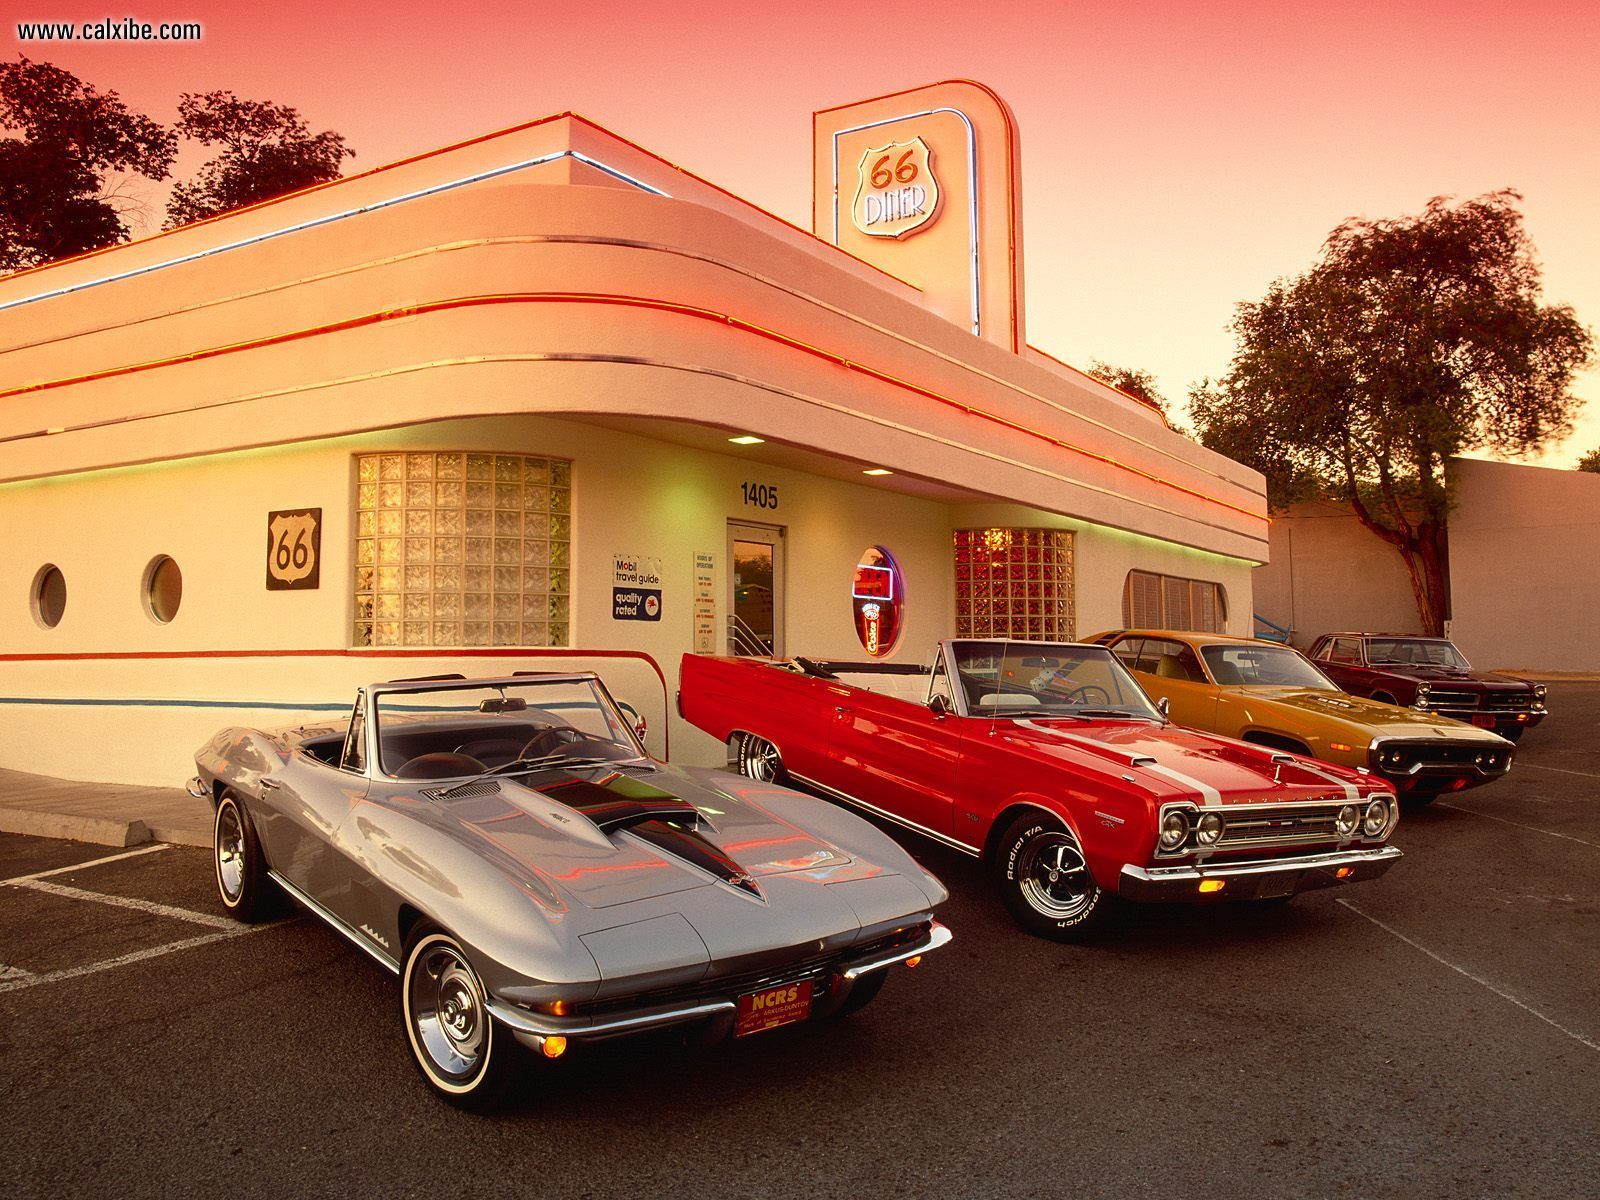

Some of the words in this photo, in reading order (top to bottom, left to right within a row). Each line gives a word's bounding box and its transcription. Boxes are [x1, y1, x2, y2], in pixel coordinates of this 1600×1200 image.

[871, 149, 918, 189] 66
[865, 186, 926, 226] DINER
[741, 481, 778, 509] 1405
[277, 528, 308, 570] 66
[616, 560, 637, 571] Mobil
[616, 572, 638, 582] travel
[639, 574, 659, 584] guide
[616, 592, 642, 605] quality
[616, 605, 637, 615] rated
[1007, 837, 1025, 880] Radial
[1025, 825, 1043, 837] T/A
[752, 987, 798, 1010] NCRS
